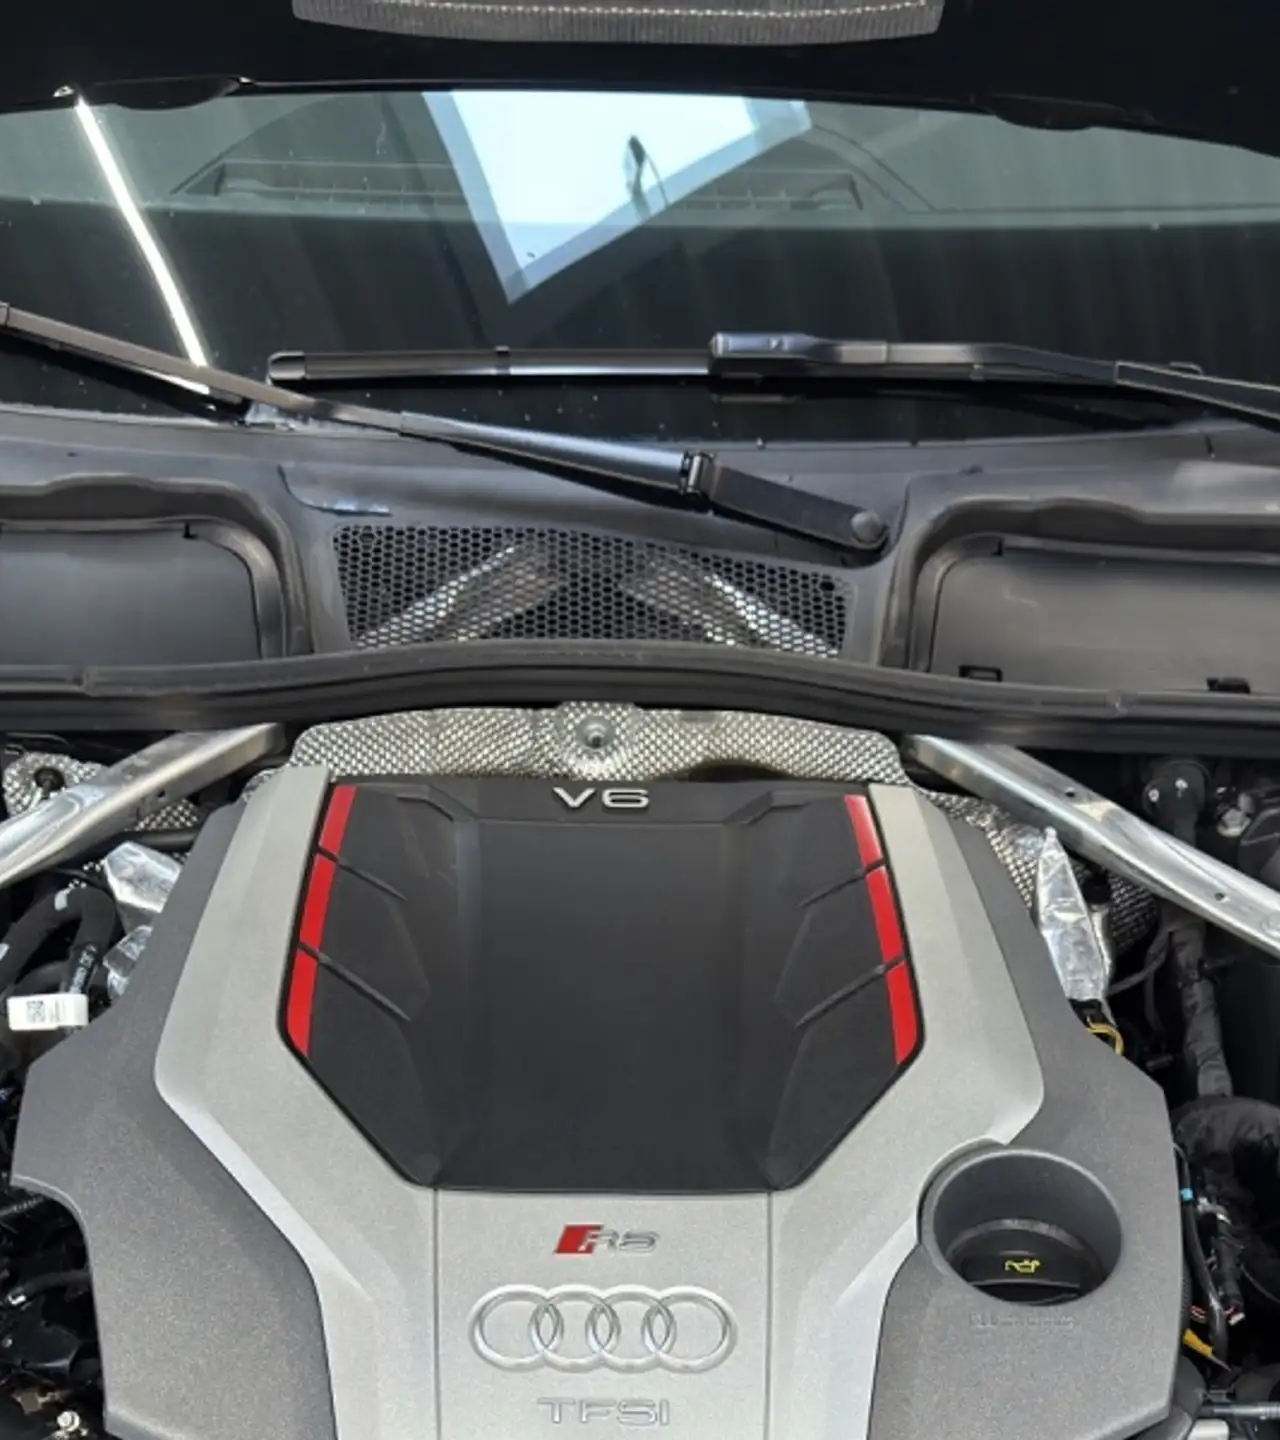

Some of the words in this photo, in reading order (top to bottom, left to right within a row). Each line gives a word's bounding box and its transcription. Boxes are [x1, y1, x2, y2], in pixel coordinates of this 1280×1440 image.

[552, 787, 650, 807] V6
[565, 1226, 660, 1253] RS
[537, 1398, 670, 1426] TFSI
